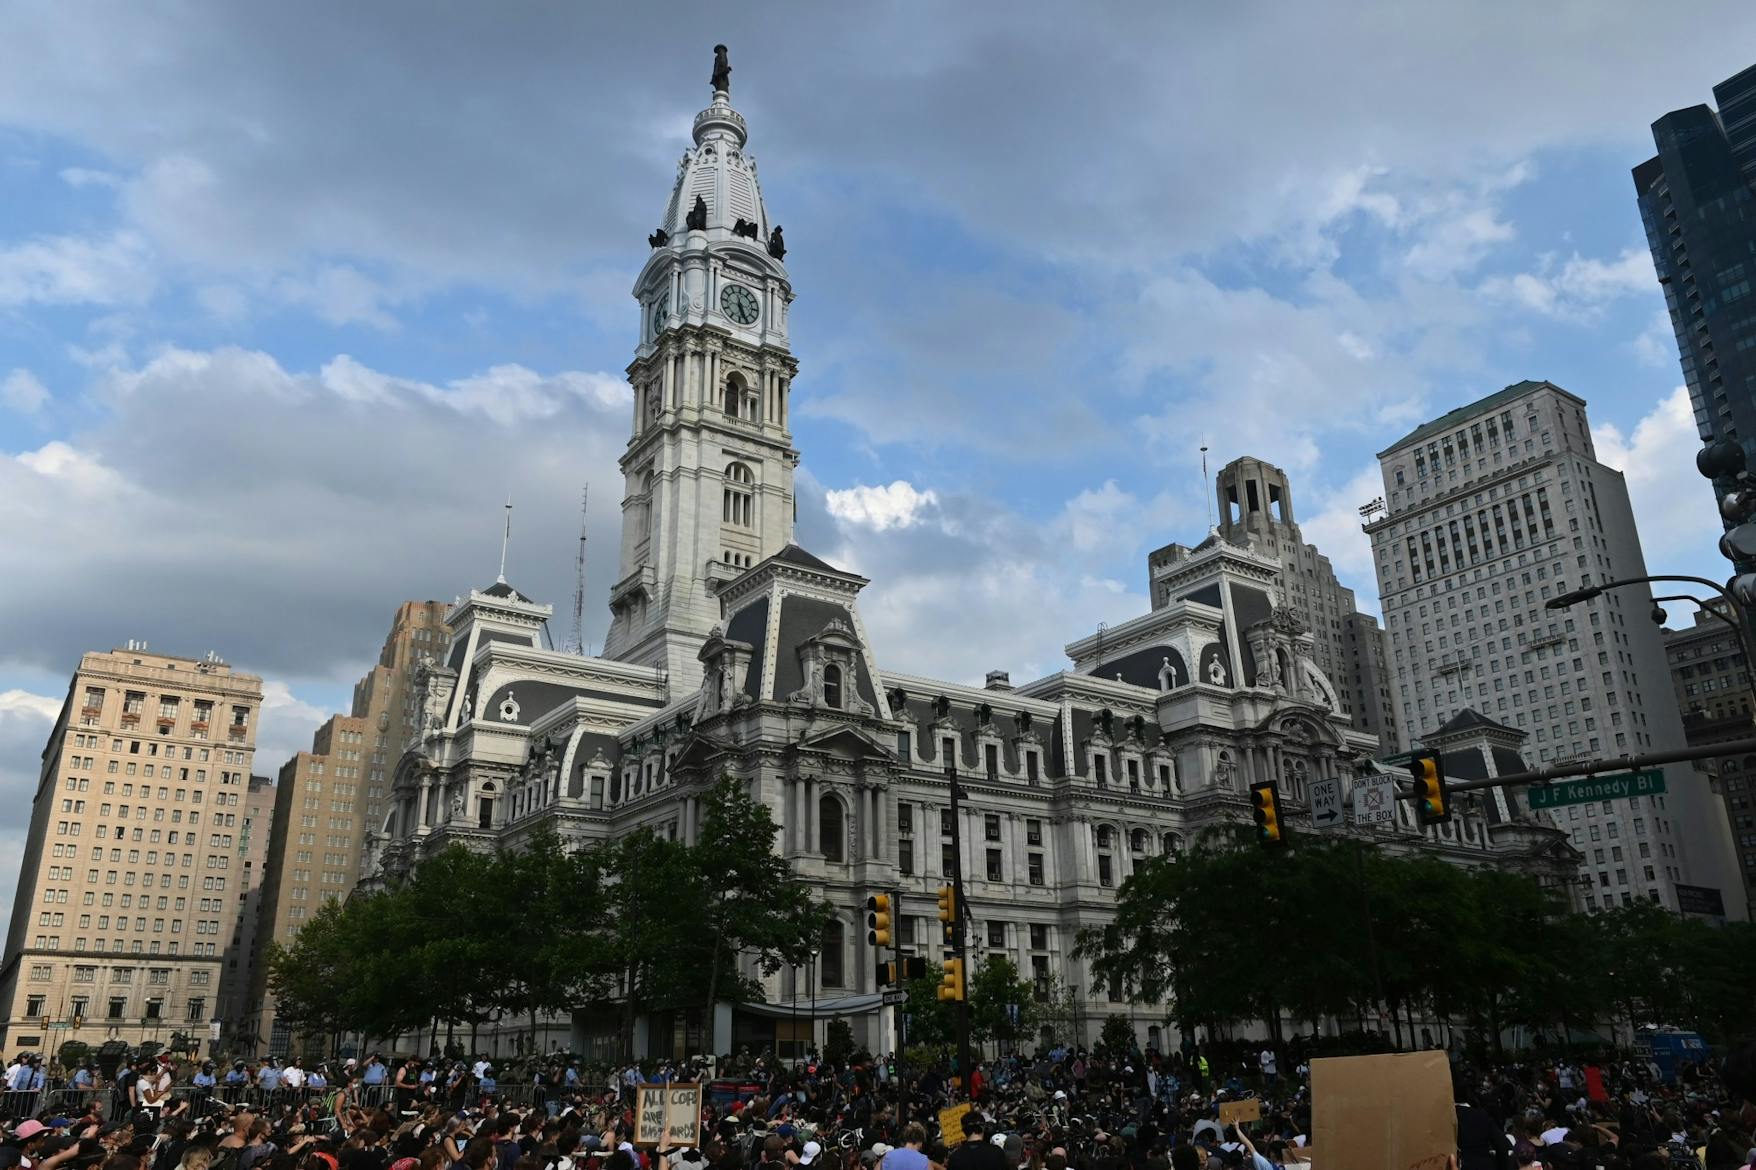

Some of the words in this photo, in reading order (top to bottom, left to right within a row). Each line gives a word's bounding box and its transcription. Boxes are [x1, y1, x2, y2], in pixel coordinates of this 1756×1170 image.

[1372, 775, 1392, 786] BLOCK
[1314, 783, 1334, 797] ONE
[1539, 790, 1546, 804] J
[1553, 788, 1561, 802] F
[1568, 779, 1630, 799] Kennedy
[1314, 796, 1336, 809] WAY
[1357, 813, 1373, 824] THE
[1376, 810, 1393, 821] BOX
[643, 1090, 665, 1109] ALL
[642, 1111, 663, 1125] ARE
